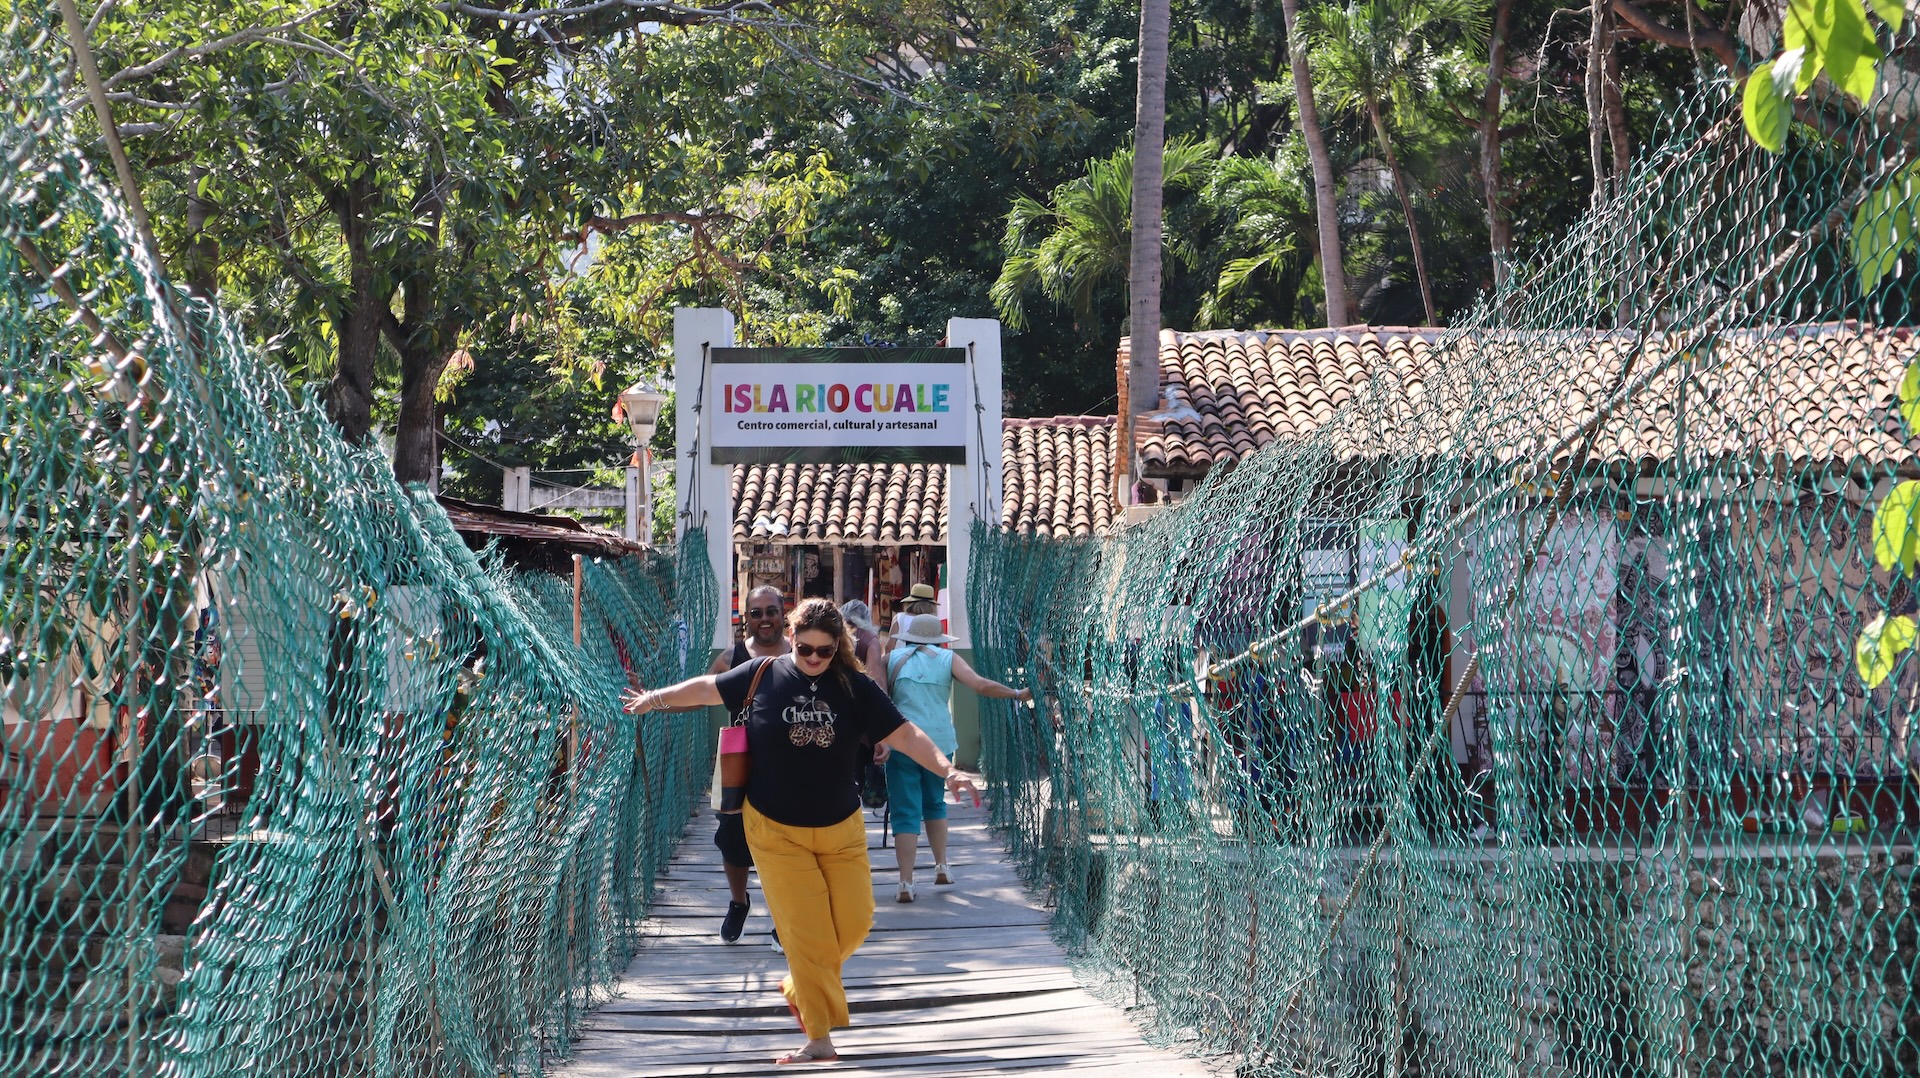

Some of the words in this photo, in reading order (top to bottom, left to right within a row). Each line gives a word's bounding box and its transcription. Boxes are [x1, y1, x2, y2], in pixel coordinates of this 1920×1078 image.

[724, 384, 789, 413] ISLA
[795, 384, 850, 413] RIO
[854, 384, 950, 413] CUALE
[737, 420, 774, 430] Centro
[775, 420, 831, 431] comercial,
[832, 420, 876, 430] cultural
[876, 422, 885, 431] y
[885, 420, 937, 430] artesanal
[781, 705, 837, 726] Cherry
